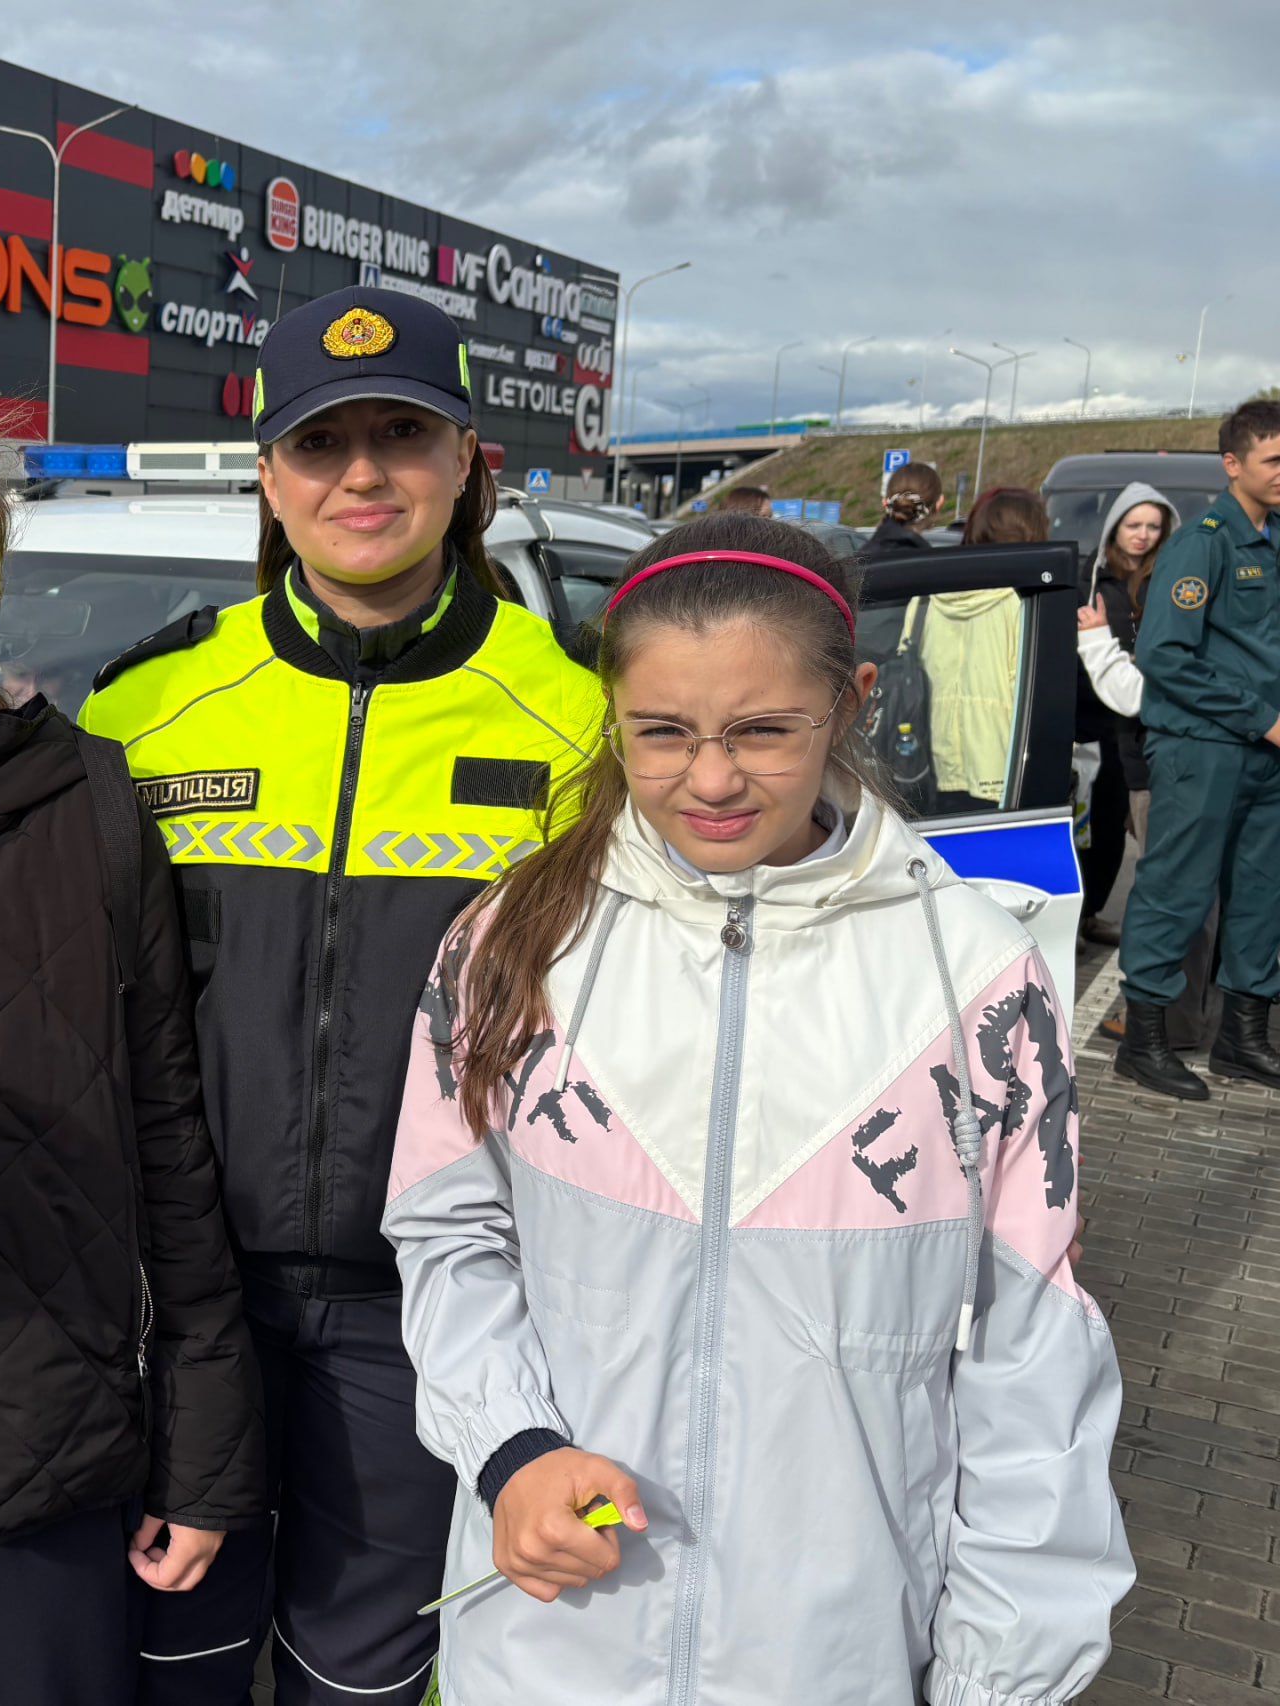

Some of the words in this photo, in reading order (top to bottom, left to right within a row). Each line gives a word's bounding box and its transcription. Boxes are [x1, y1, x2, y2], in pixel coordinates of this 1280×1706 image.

[161, 190, 245, 242] детмир
[271, 214, 297, 238] KING
[303, 205, 383, 265] BURGER
[385, 230, 430, 277] KING
[452, 249, 486, 291] MF
[142, 777, 248, 807] МІЛІЦЫЯ
